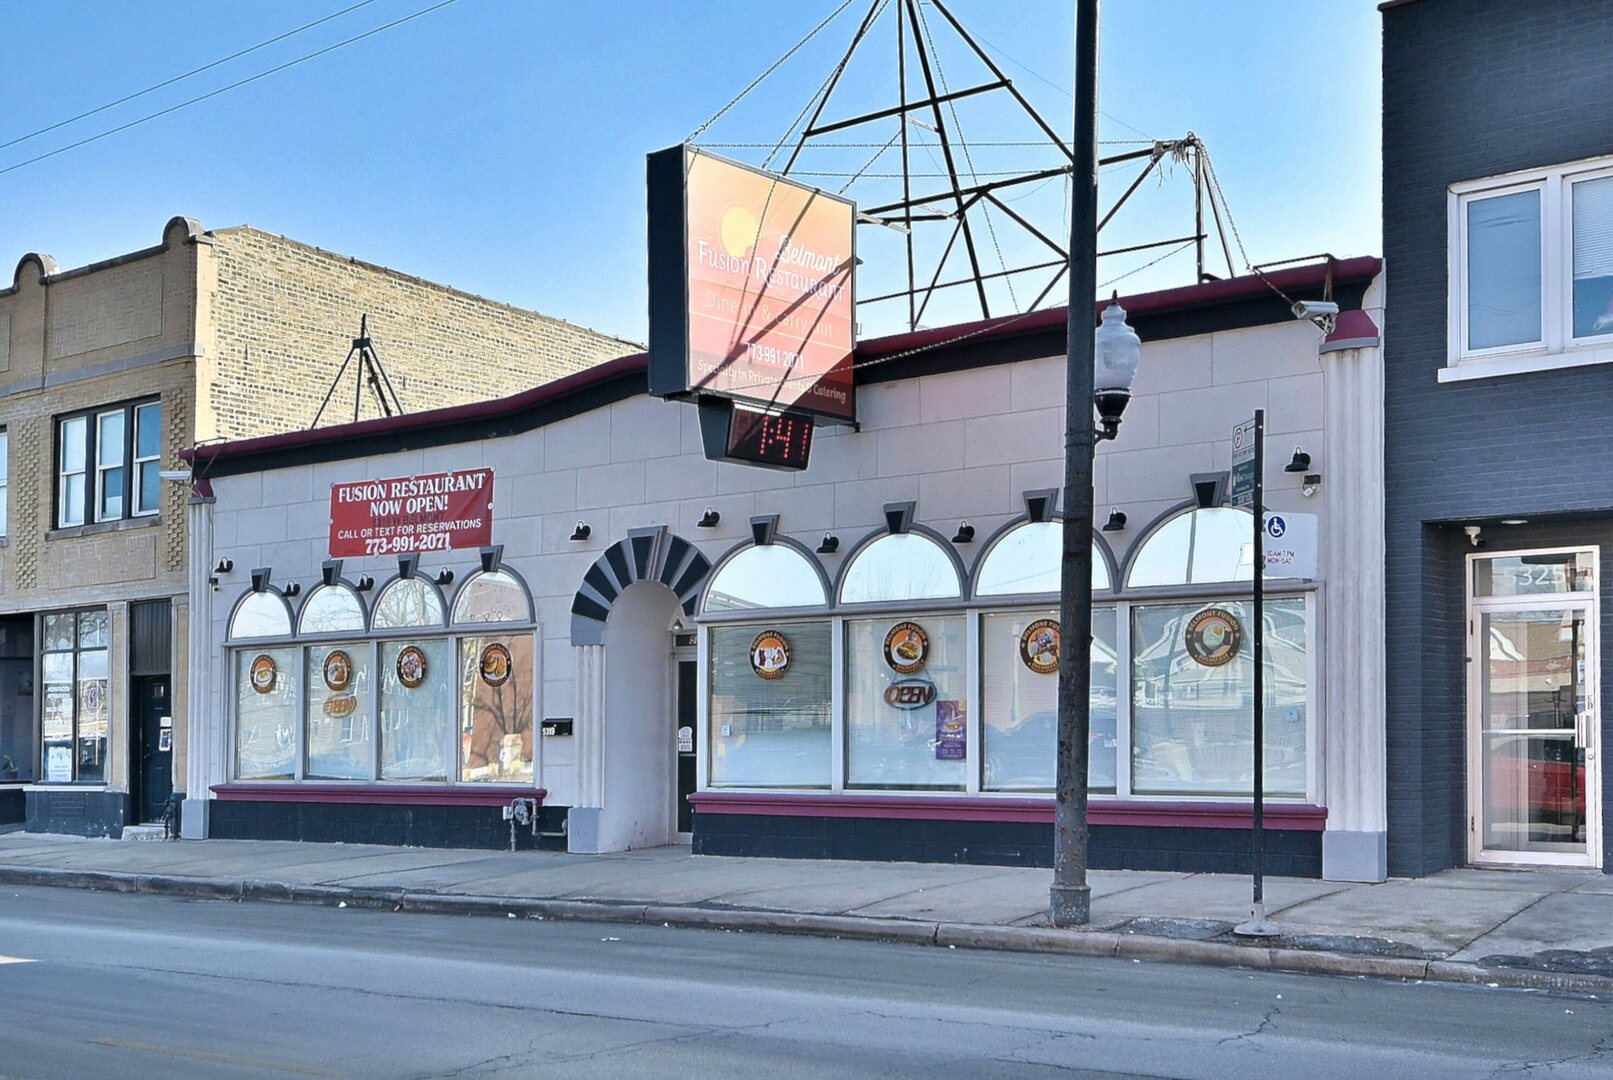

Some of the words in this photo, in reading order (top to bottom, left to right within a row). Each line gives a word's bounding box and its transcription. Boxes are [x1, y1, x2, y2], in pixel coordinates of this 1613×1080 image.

[698, 239, 751, 275] Fusion
[775, 234, 841, 276] Belmont
[705, 290, 738, 314] Dine
[744, 302, 757, 317] in
[761, 304, 772, 321] &
[745, 341, 804, 371] 773-991-2071
[698, 359, 737, 382] Specialty
[737, 366, 748, 380] in
[813, 383, 847, 405] Catering
[759, 415, 811, 461] 1:41
[338, 483, 387, 503] FUSION
[391, 472, 486, 498] RESTAURANT
[370, 500, 405, 517] NOW
[406, 494, 449, 513] OPEN!
[403, 511, 445, 525] BELMONT
[338, 529, 358, 539] CALL
[360, 528, 373, 538] OR
[375, 526, 395, 537] TEXT
[397, 524, 414, 535] FOR
[416, 518, 481, 533] RESERVATIONS
[365, 532, 450, 554] 773-991-2071
[1504, 565, 1566, 587] 5325
[1187, 610, 1216, 632] BELMONT
[1217, 610, 1240, 631] FUSION
[885, 623, 907, 646] BELMONT
